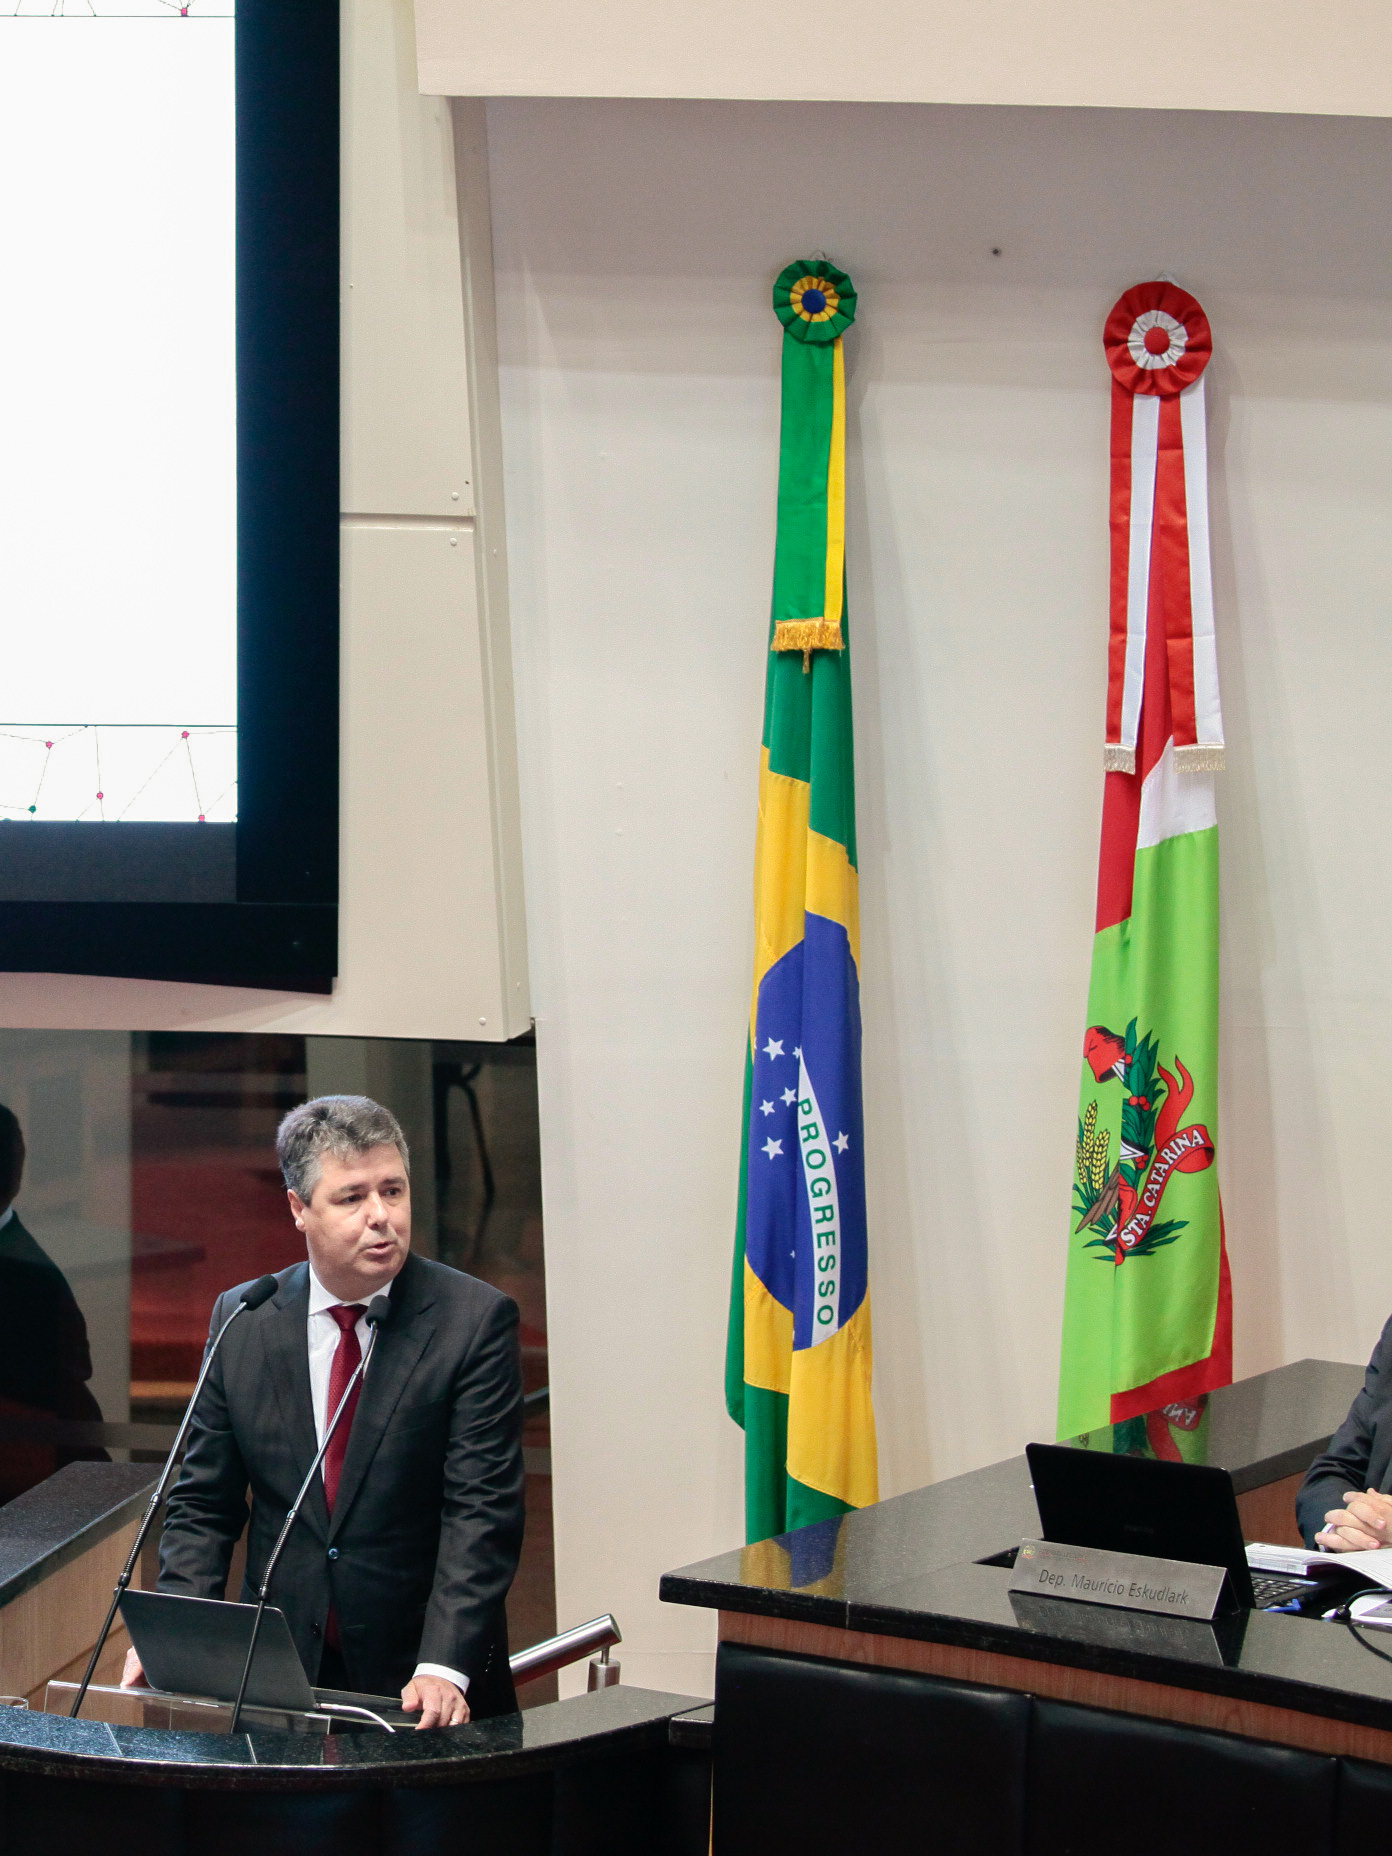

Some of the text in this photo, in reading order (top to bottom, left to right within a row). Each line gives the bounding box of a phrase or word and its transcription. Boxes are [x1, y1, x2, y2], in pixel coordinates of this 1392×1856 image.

[797, 1097, 835, 1326] PROGRESSO
[1120, 1129, 1205, 1247] STA. CATARINA
[1039, 1569, 1067, 1588] Dep.
[1128, 1582, 1189, 1605] Eskudlark
